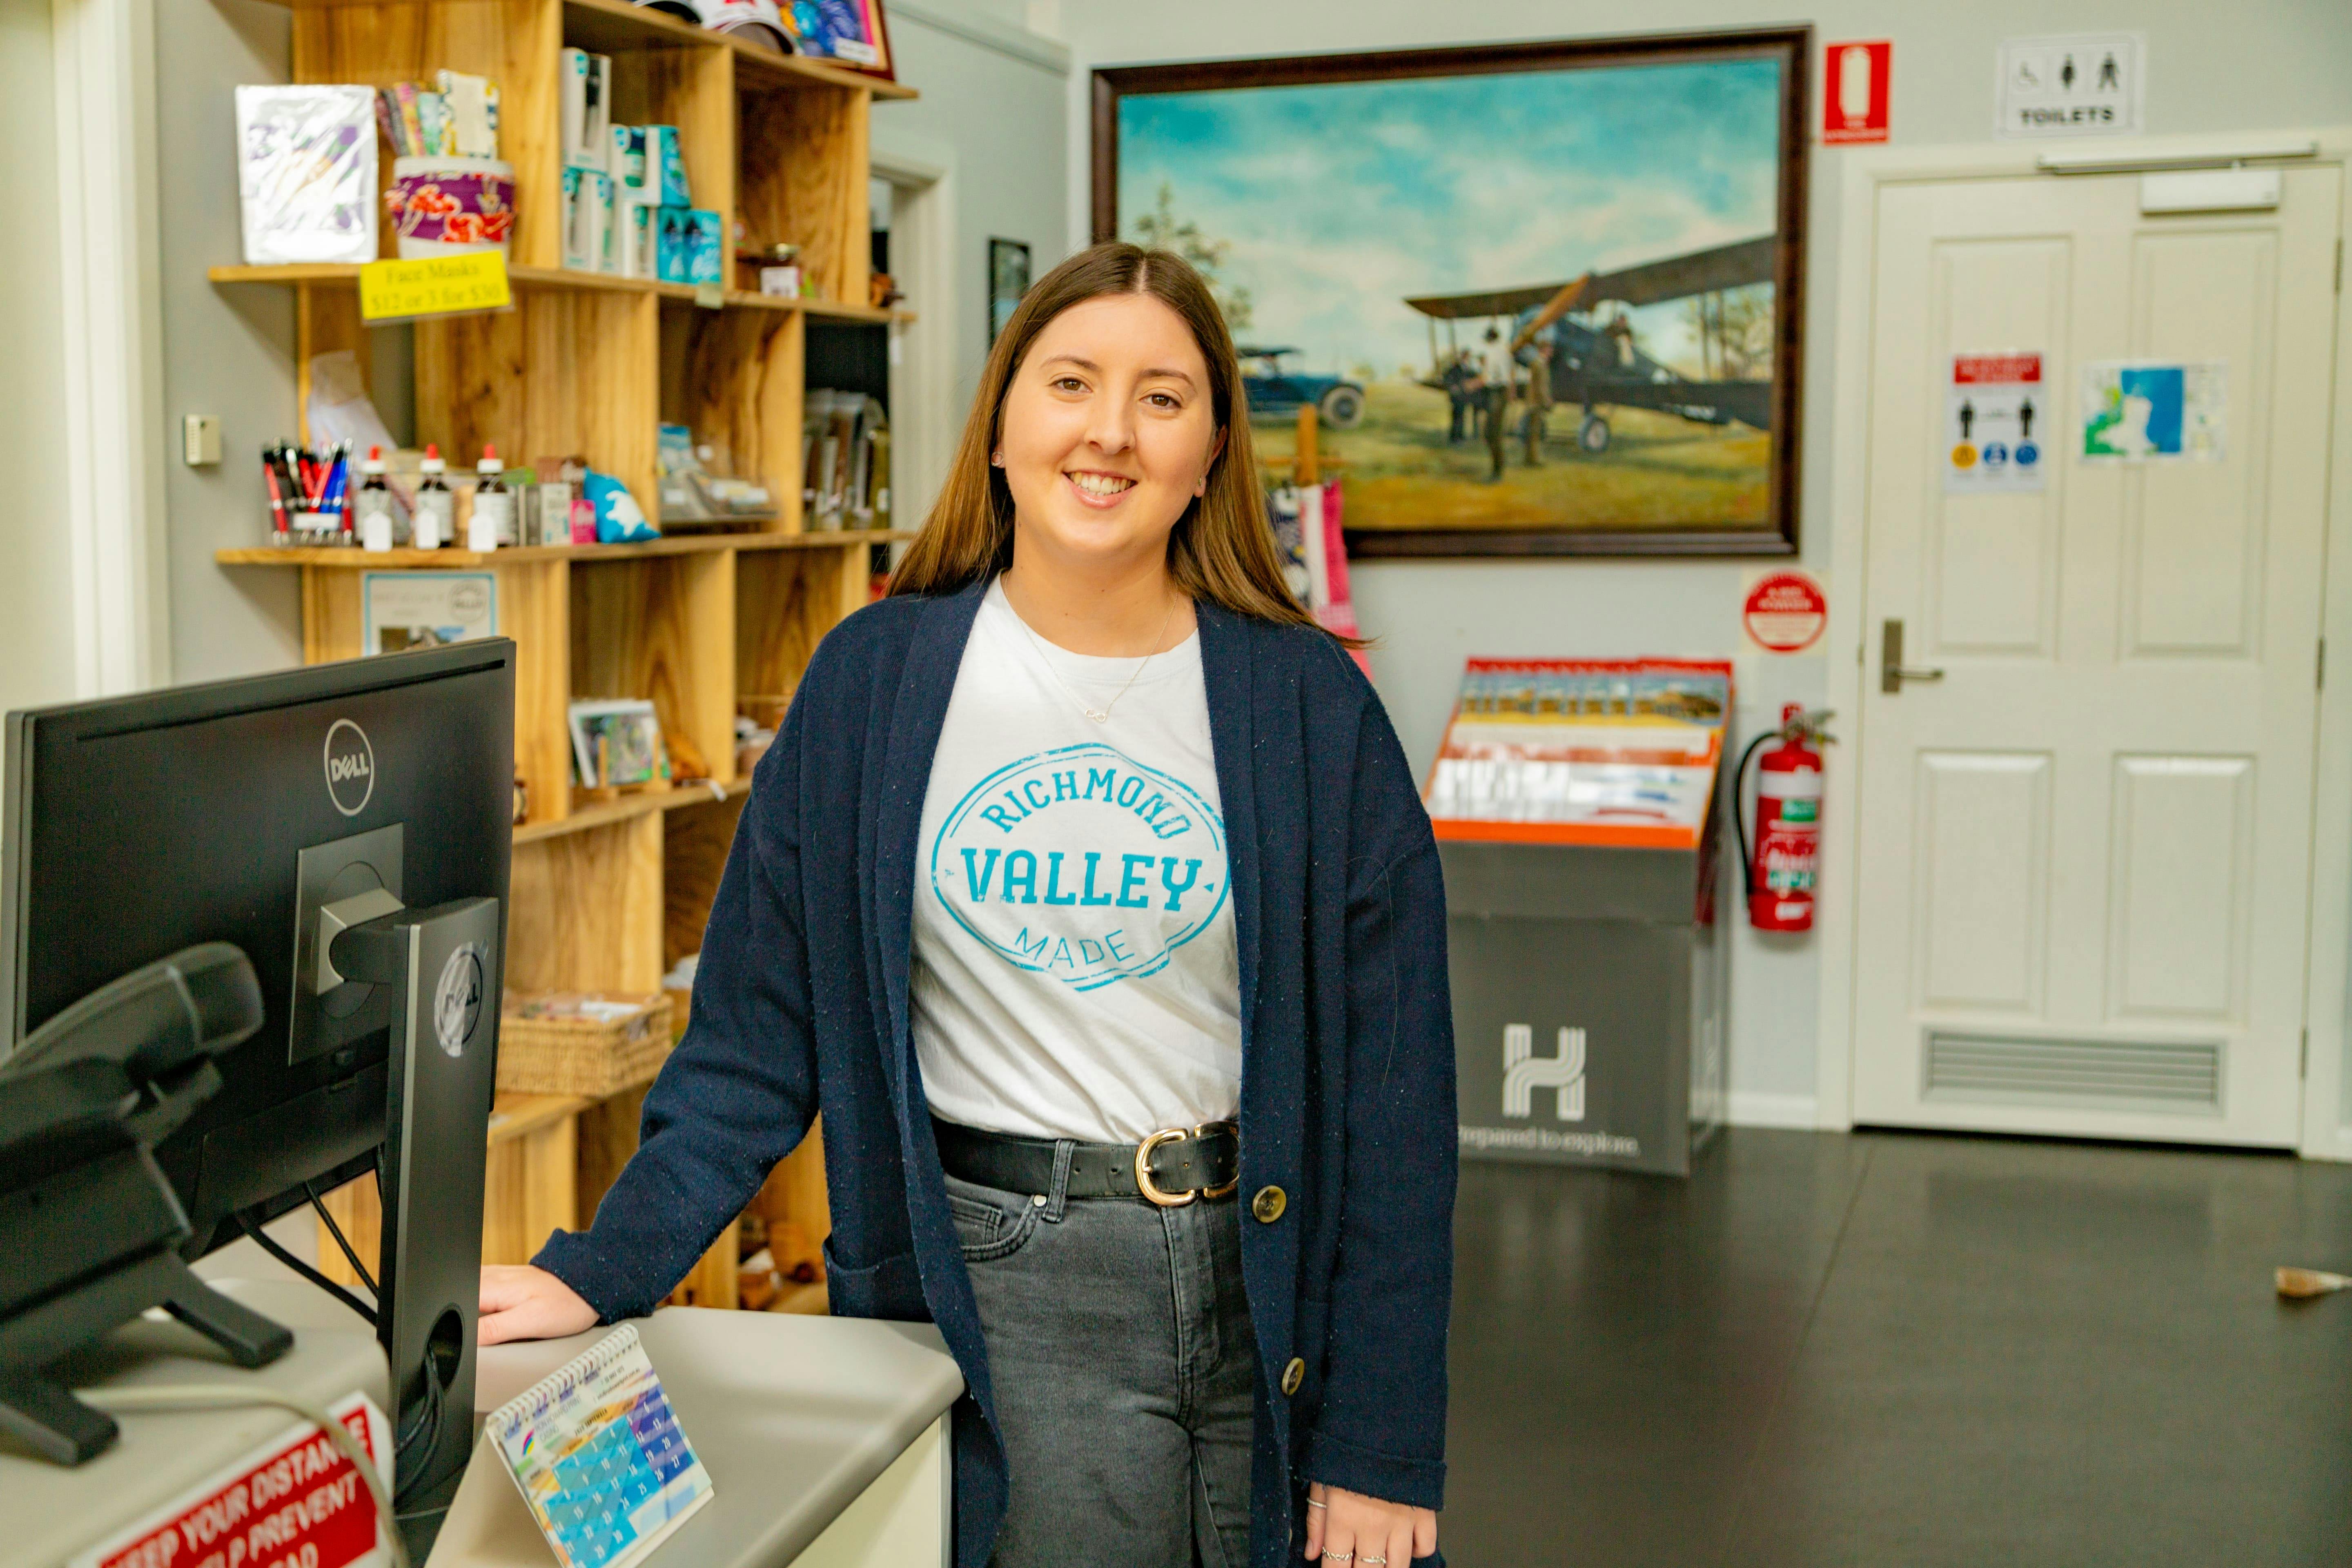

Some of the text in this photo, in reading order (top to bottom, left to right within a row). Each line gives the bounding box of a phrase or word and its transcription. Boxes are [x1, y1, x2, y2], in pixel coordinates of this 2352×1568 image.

[2020, 107, 2114, 125] TOILETS
[387, 267, 421, 283] Face
[330, 753, 369, 782] DELL
[980, 768, 1192, 840] RICHMOND
[960, 848, 1202, 912] VALLEY
[1014, 927, 1135, 969] MADE
[445, 984, 478, 1013] DELL
[644, 1401, 650, 1413] 6
[619, 1444, 627, 1457] 11
[636, 1430, 645, 1444] 12
[653, 1417, 662, 1430] 13
[646, 1450, 654, 1463] 19
[662, 1437, 671, 1450] 20
[180, 1484, 249, 1553] YOUR
[252, 1415, 368, 1510] DISTANE
[620, 1496, 630, 1510] 24
[638, 1482, 648, 1495] 25
[655, 1468, 664, 1482] 26
[671, 1454, 679, 1468] 27
[248, 1470, 359, 1562] PREVENT
